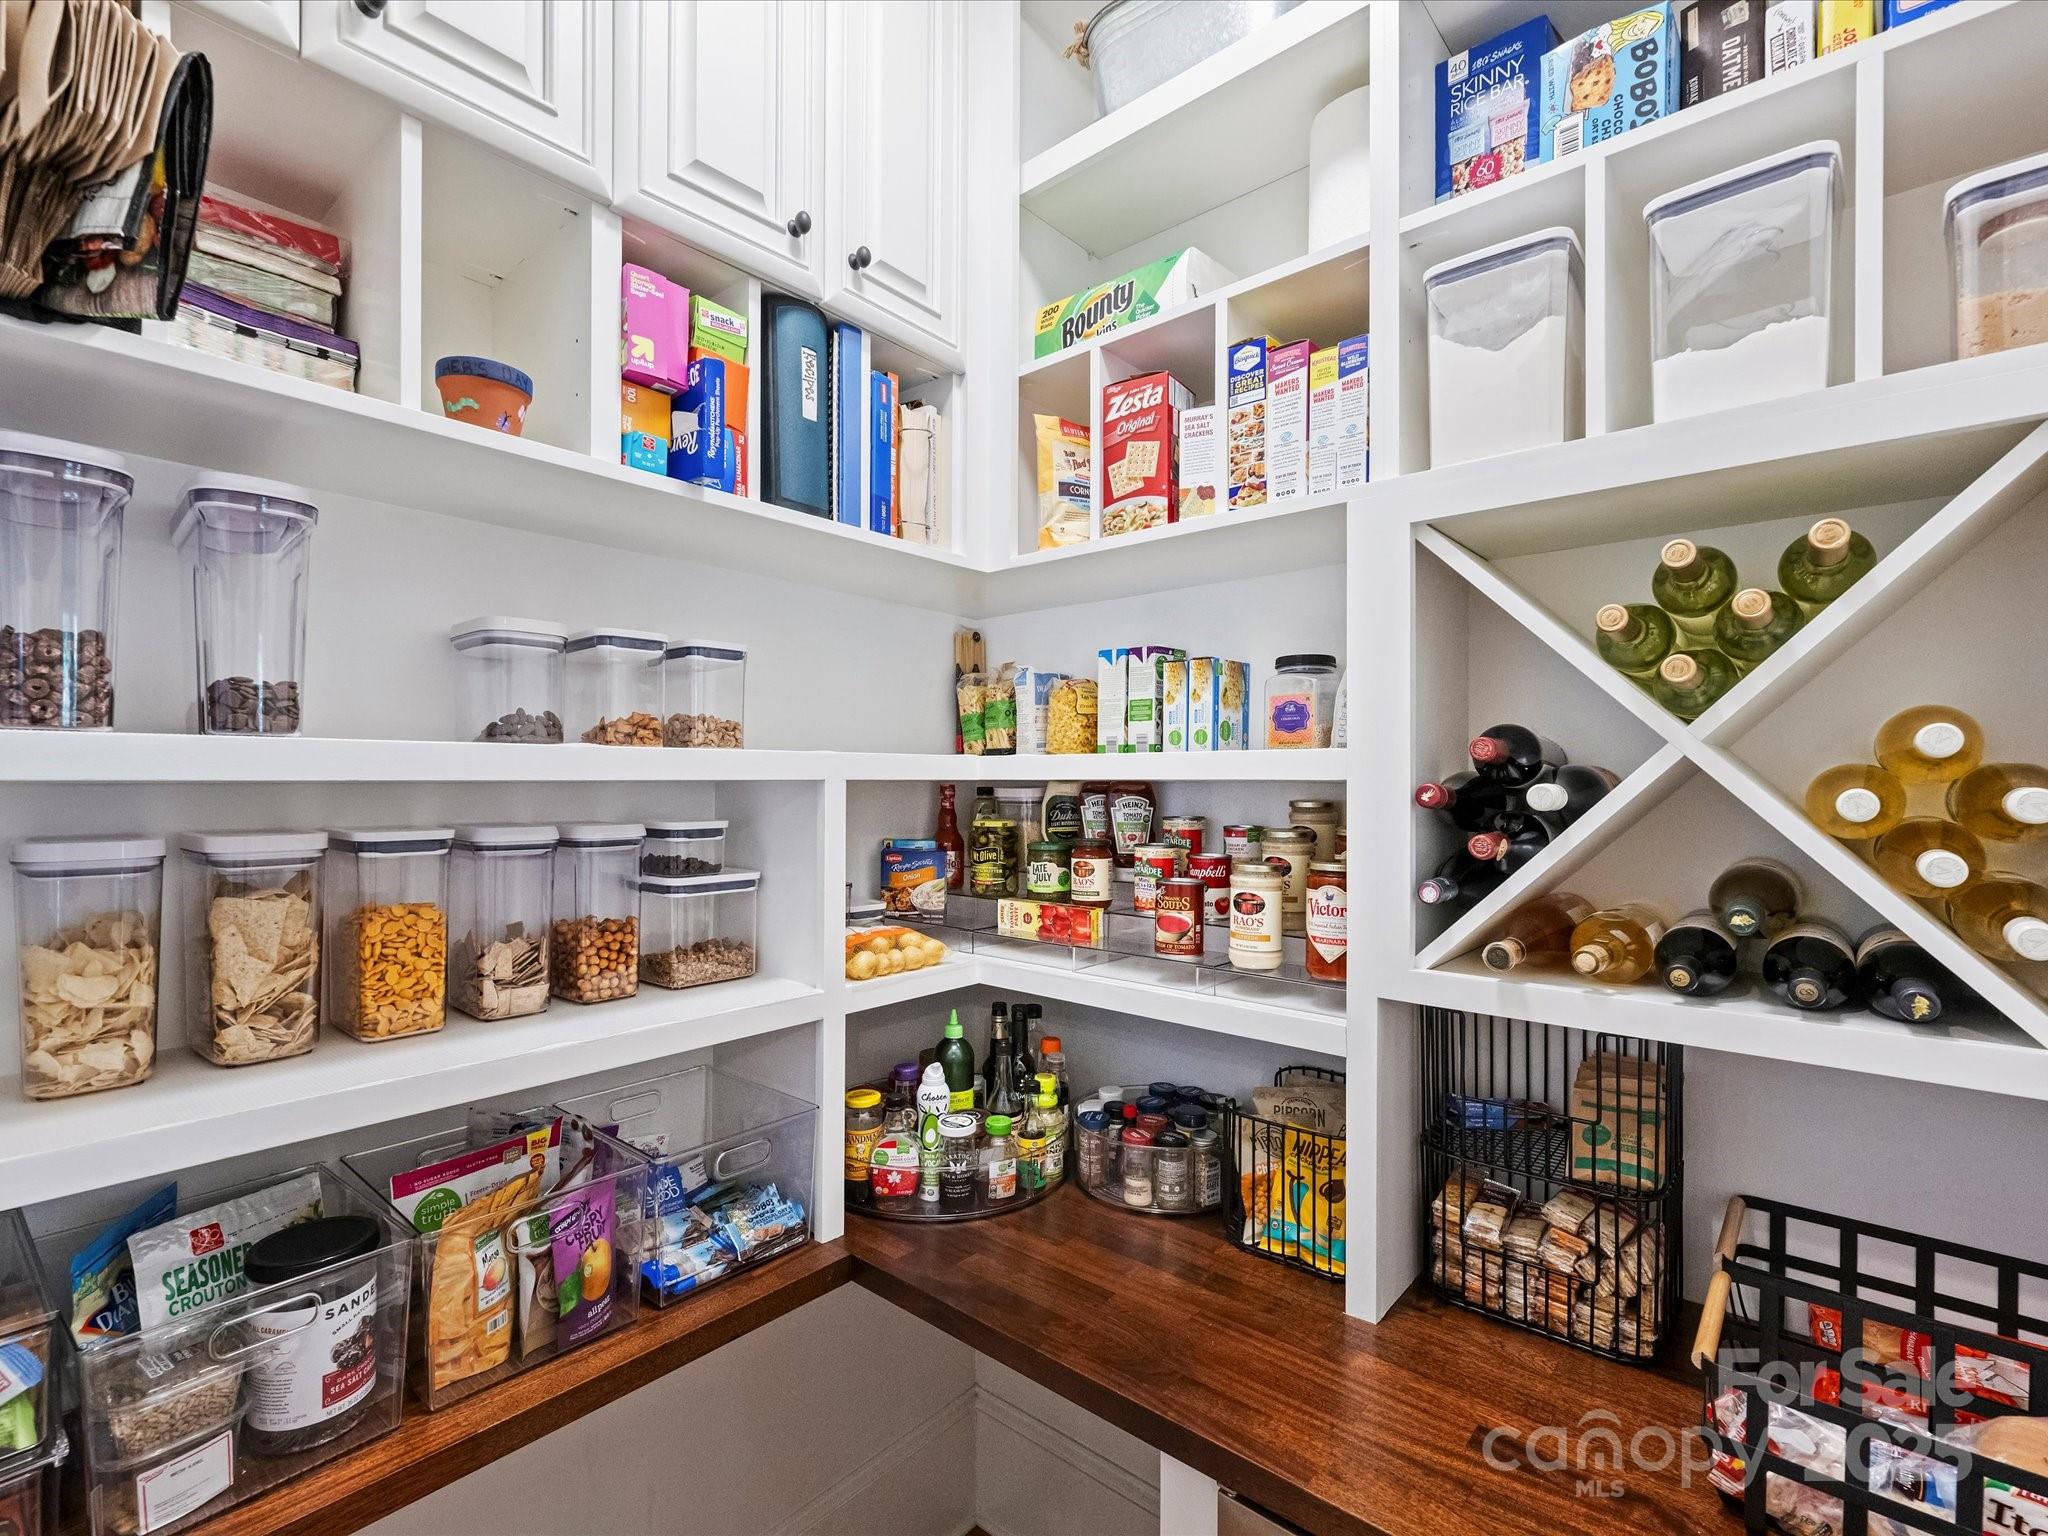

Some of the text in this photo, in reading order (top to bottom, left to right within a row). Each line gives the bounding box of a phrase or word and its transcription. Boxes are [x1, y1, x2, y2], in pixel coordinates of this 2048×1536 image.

[1450, 59, 1467, 74] 40
[1451, 54, 1525, 103] SKINNY
[1688, 75, 1699, 105] KODIAK
[1450, 91, 1487, 118] RICE
[1476, 159, 1495, 177] 60
[629, 270, 650, 281] Quart
[1042, 304, 1060, 319] 200
[1061, 279, 1135, 350] Bounty
[710, 314, 735, 327] snack
[1230, 369, 1264, 384] DISCOVER
[1235, 375, 1265, 389] GREAT
[1341, 376, 1364, 386] MAKERS
[1234, 382, 1264, 395] RECIPES
[1274, 377, 1300, 390] MAKERS
[1274, 384, 1300, 396] WANTED
[1341, 382, 1364, 393] WANTED
[1313, 388, 1335, 399] MAKERS
[1313, 394, 1335, 404] WANTED
[1104, 383, 1164, 423] Zesta
[1117, 411, 1155, 436] Original
[1184, 413, 1213, 423] MURRAY'S
[1063, 426, 1085, 438] GLUTEN
[1184, 421, 1210, 432] SEA SALT
[1184, 430, 1214, 439] CRACKERS
[1072, 459, 1087, 472] Red
[1121, 801, 1144, 810] HEINZ
[885, 854, 903, 862] Lipton
[979, 850, 997, 862] Olive
[1032, 863, 1048, 875] LATE
[902, 872, 921, 882] Onion
[1033, 872, 1052, 885] JULY
[1157, 896, 1191, 911] SOUPS
[1232, 914, 1265, 928] RAO'S
[1173, 943, 1195, 951] TOMATO
[1315, 936, 1346, 946] MARINARA
[921, 1093, 948, 1102] Chosen
[530, 1136, 548, 1147] BIG
[466, 1154, 499, 1170] GLUTEN FREE
[423, 1173, 441, 1184] SUGAR
[441, 1167, 461, 1177] ADDED
[420, 1198, 456, 1216] simple
[421, 1206, 457, 1226] truth
[578, 1218, 607, 1254] FRUIT
[332, 1317, 353, 1336] SMALL
[329, 1383, 346, 1396] SEA
[346, 1371, 363, 1388] SALT
